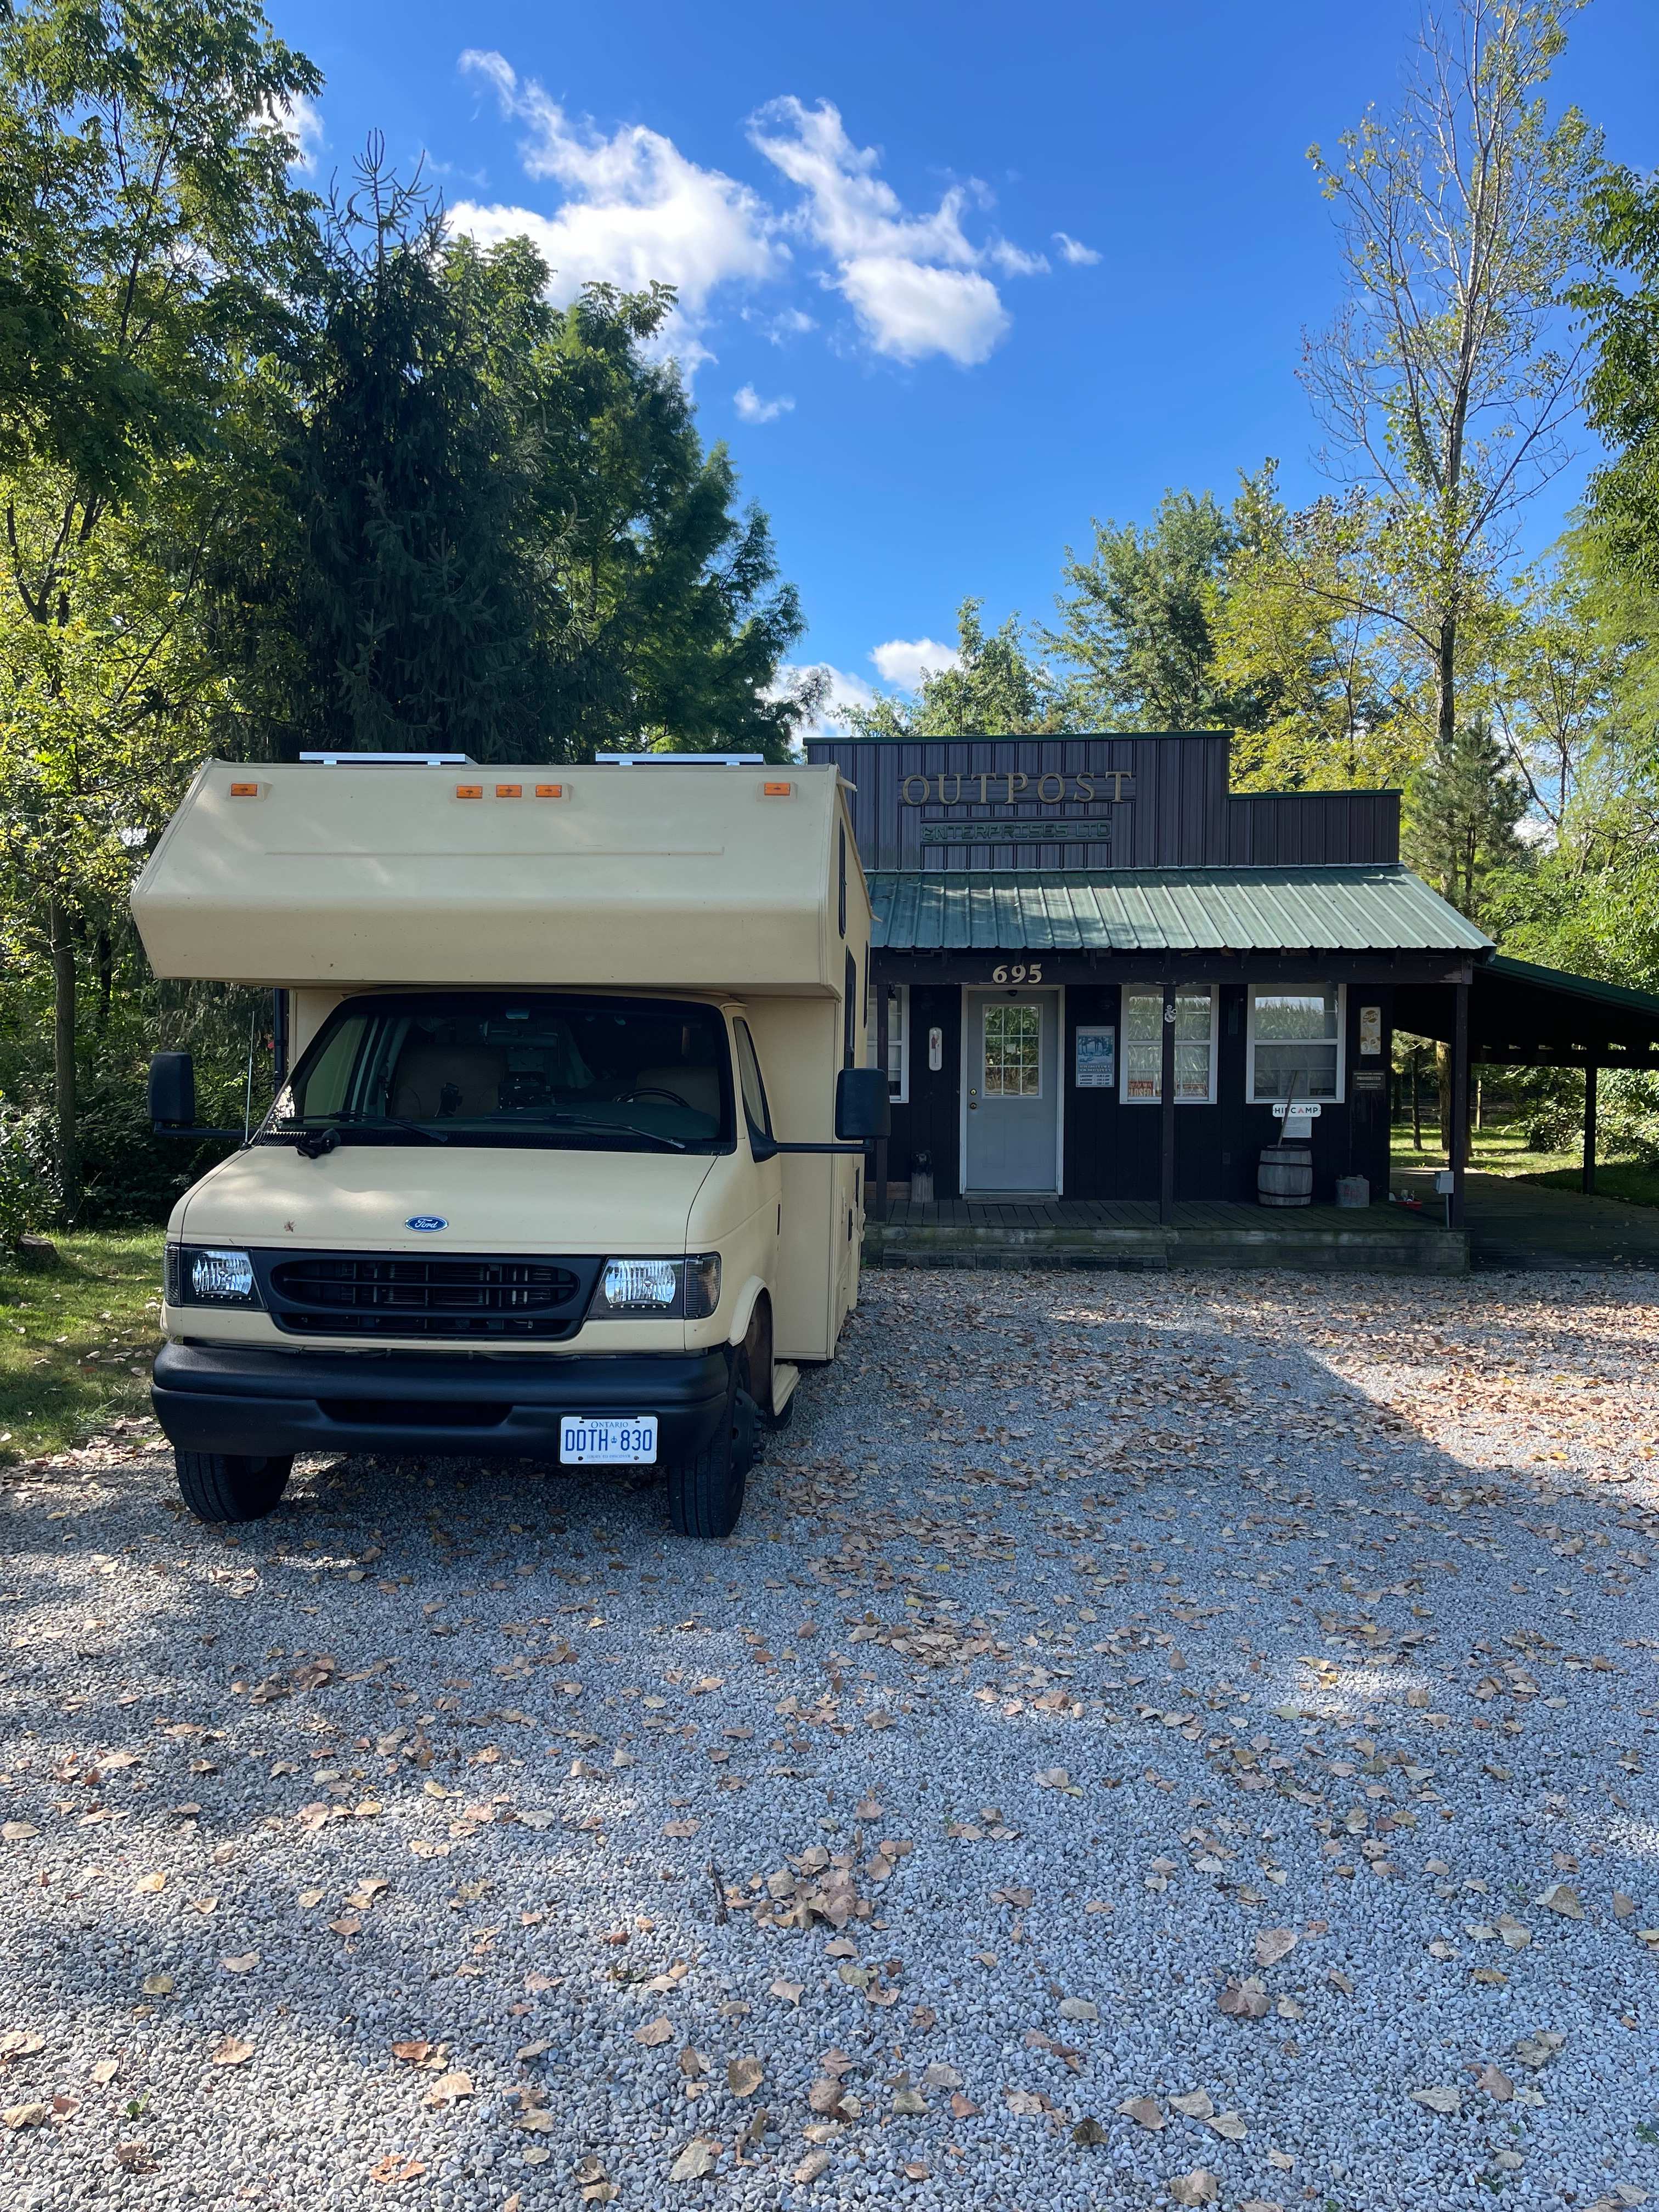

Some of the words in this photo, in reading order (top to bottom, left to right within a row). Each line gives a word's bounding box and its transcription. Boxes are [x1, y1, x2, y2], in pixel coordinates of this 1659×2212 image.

[901, 771, 1132, 807] OUTPOST
[922, 823, 1069, 841] ENTERPRISES
[1075, 822, 1111, 837] LTD
[992, 963, 1043, 984] 695
[415, 1218, 438, 1228] Ford
[565, 1429, 608, 1451] DDTH
[620, 1429, 652, 1451] 830
